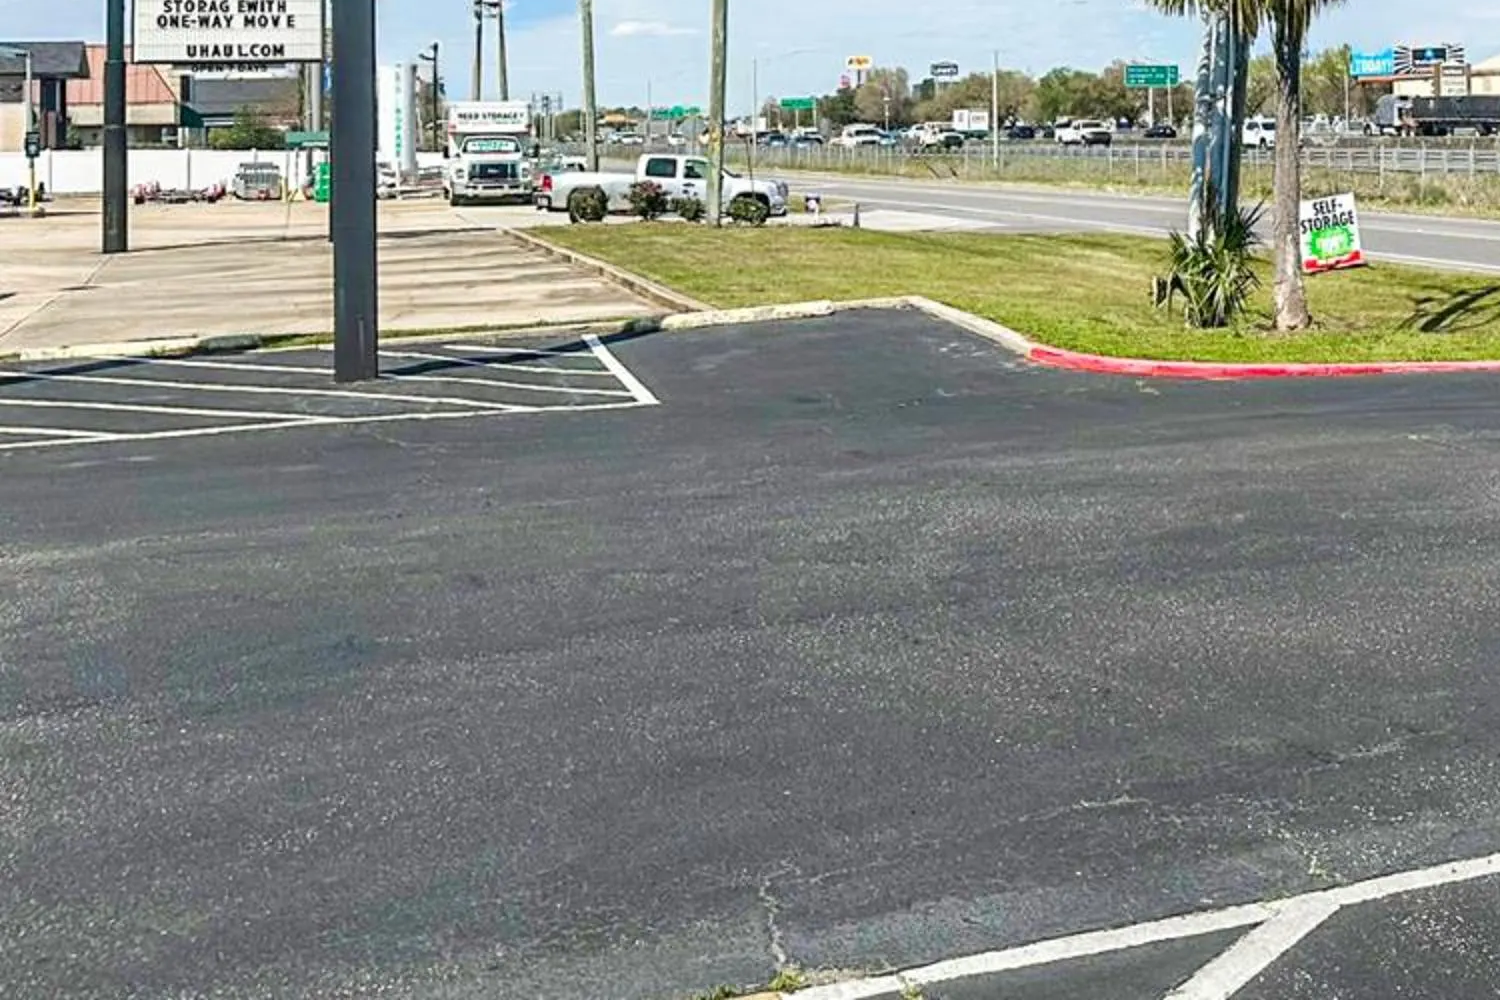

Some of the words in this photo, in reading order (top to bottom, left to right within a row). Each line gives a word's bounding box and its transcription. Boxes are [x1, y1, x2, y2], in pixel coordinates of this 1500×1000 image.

[157, 14, 234, 28] ONE-WAY
[1312, 198, 1343, 216] SELF-
[1300, 209, 1354, 234] STORAGE
